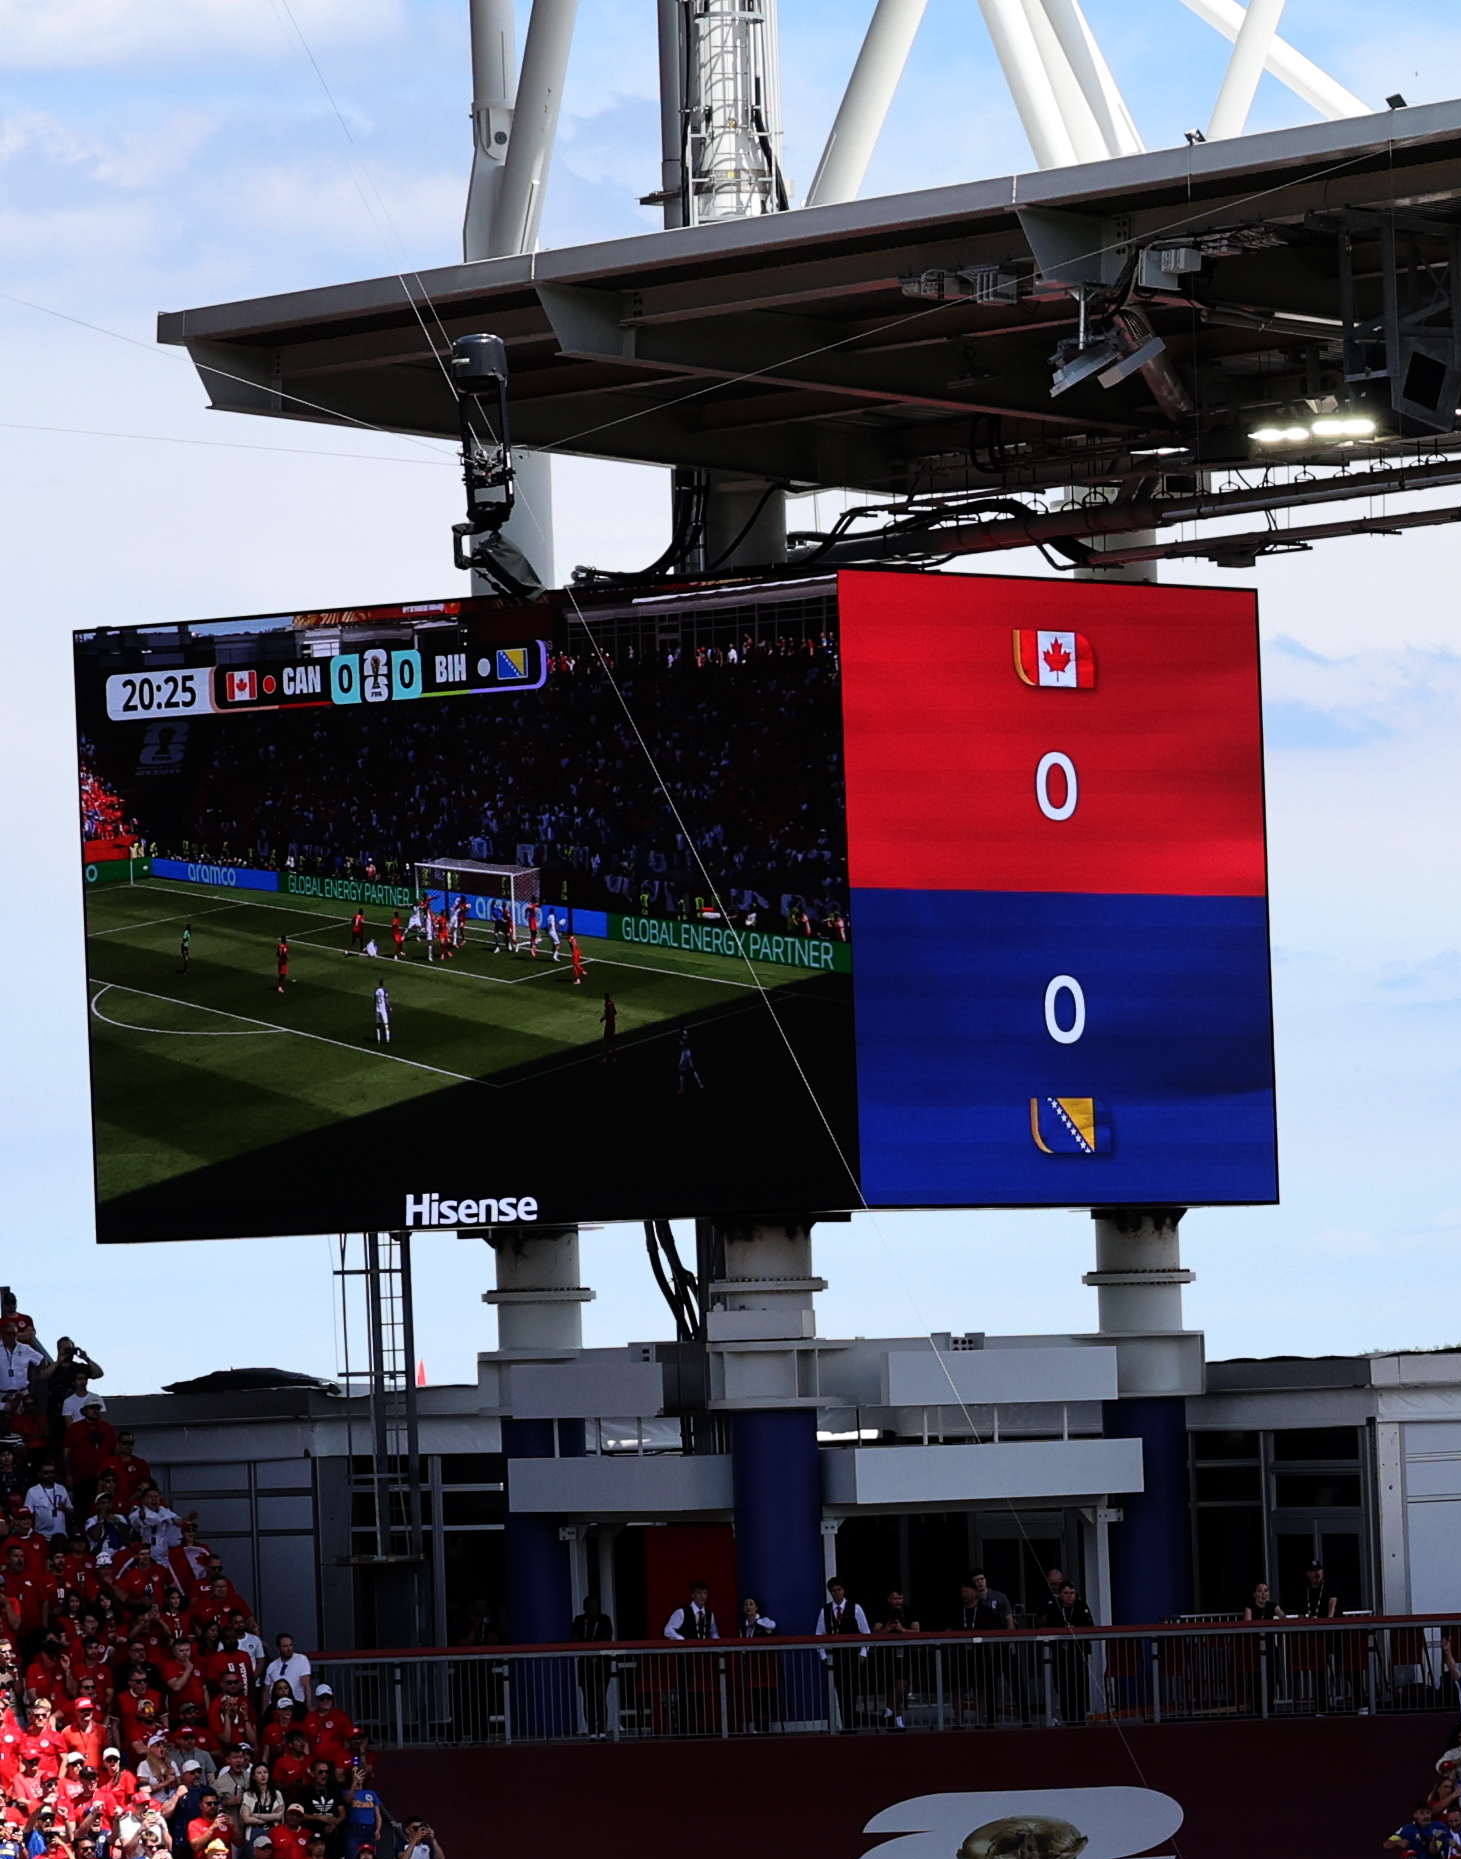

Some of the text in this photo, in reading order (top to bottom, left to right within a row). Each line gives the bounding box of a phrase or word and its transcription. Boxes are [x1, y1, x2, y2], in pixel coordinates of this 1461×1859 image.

[282, 665, 353, 695] CAN 0
[399, 654, 467, 689] 0 BIH
[122, 675, 197, 712] 20:25
[1035, 751, 1079, 821] 0
[188, 863, 236, 886] aramco
[288, 874, 410, 906] GLOBAL ENERGY PARTNER
[621, 917, 835, 970] GLOBAL ENERGY PARTNER
[1044, 975, 1086, 1044] 0
[405, 1192, 538, 1227] Hisense
